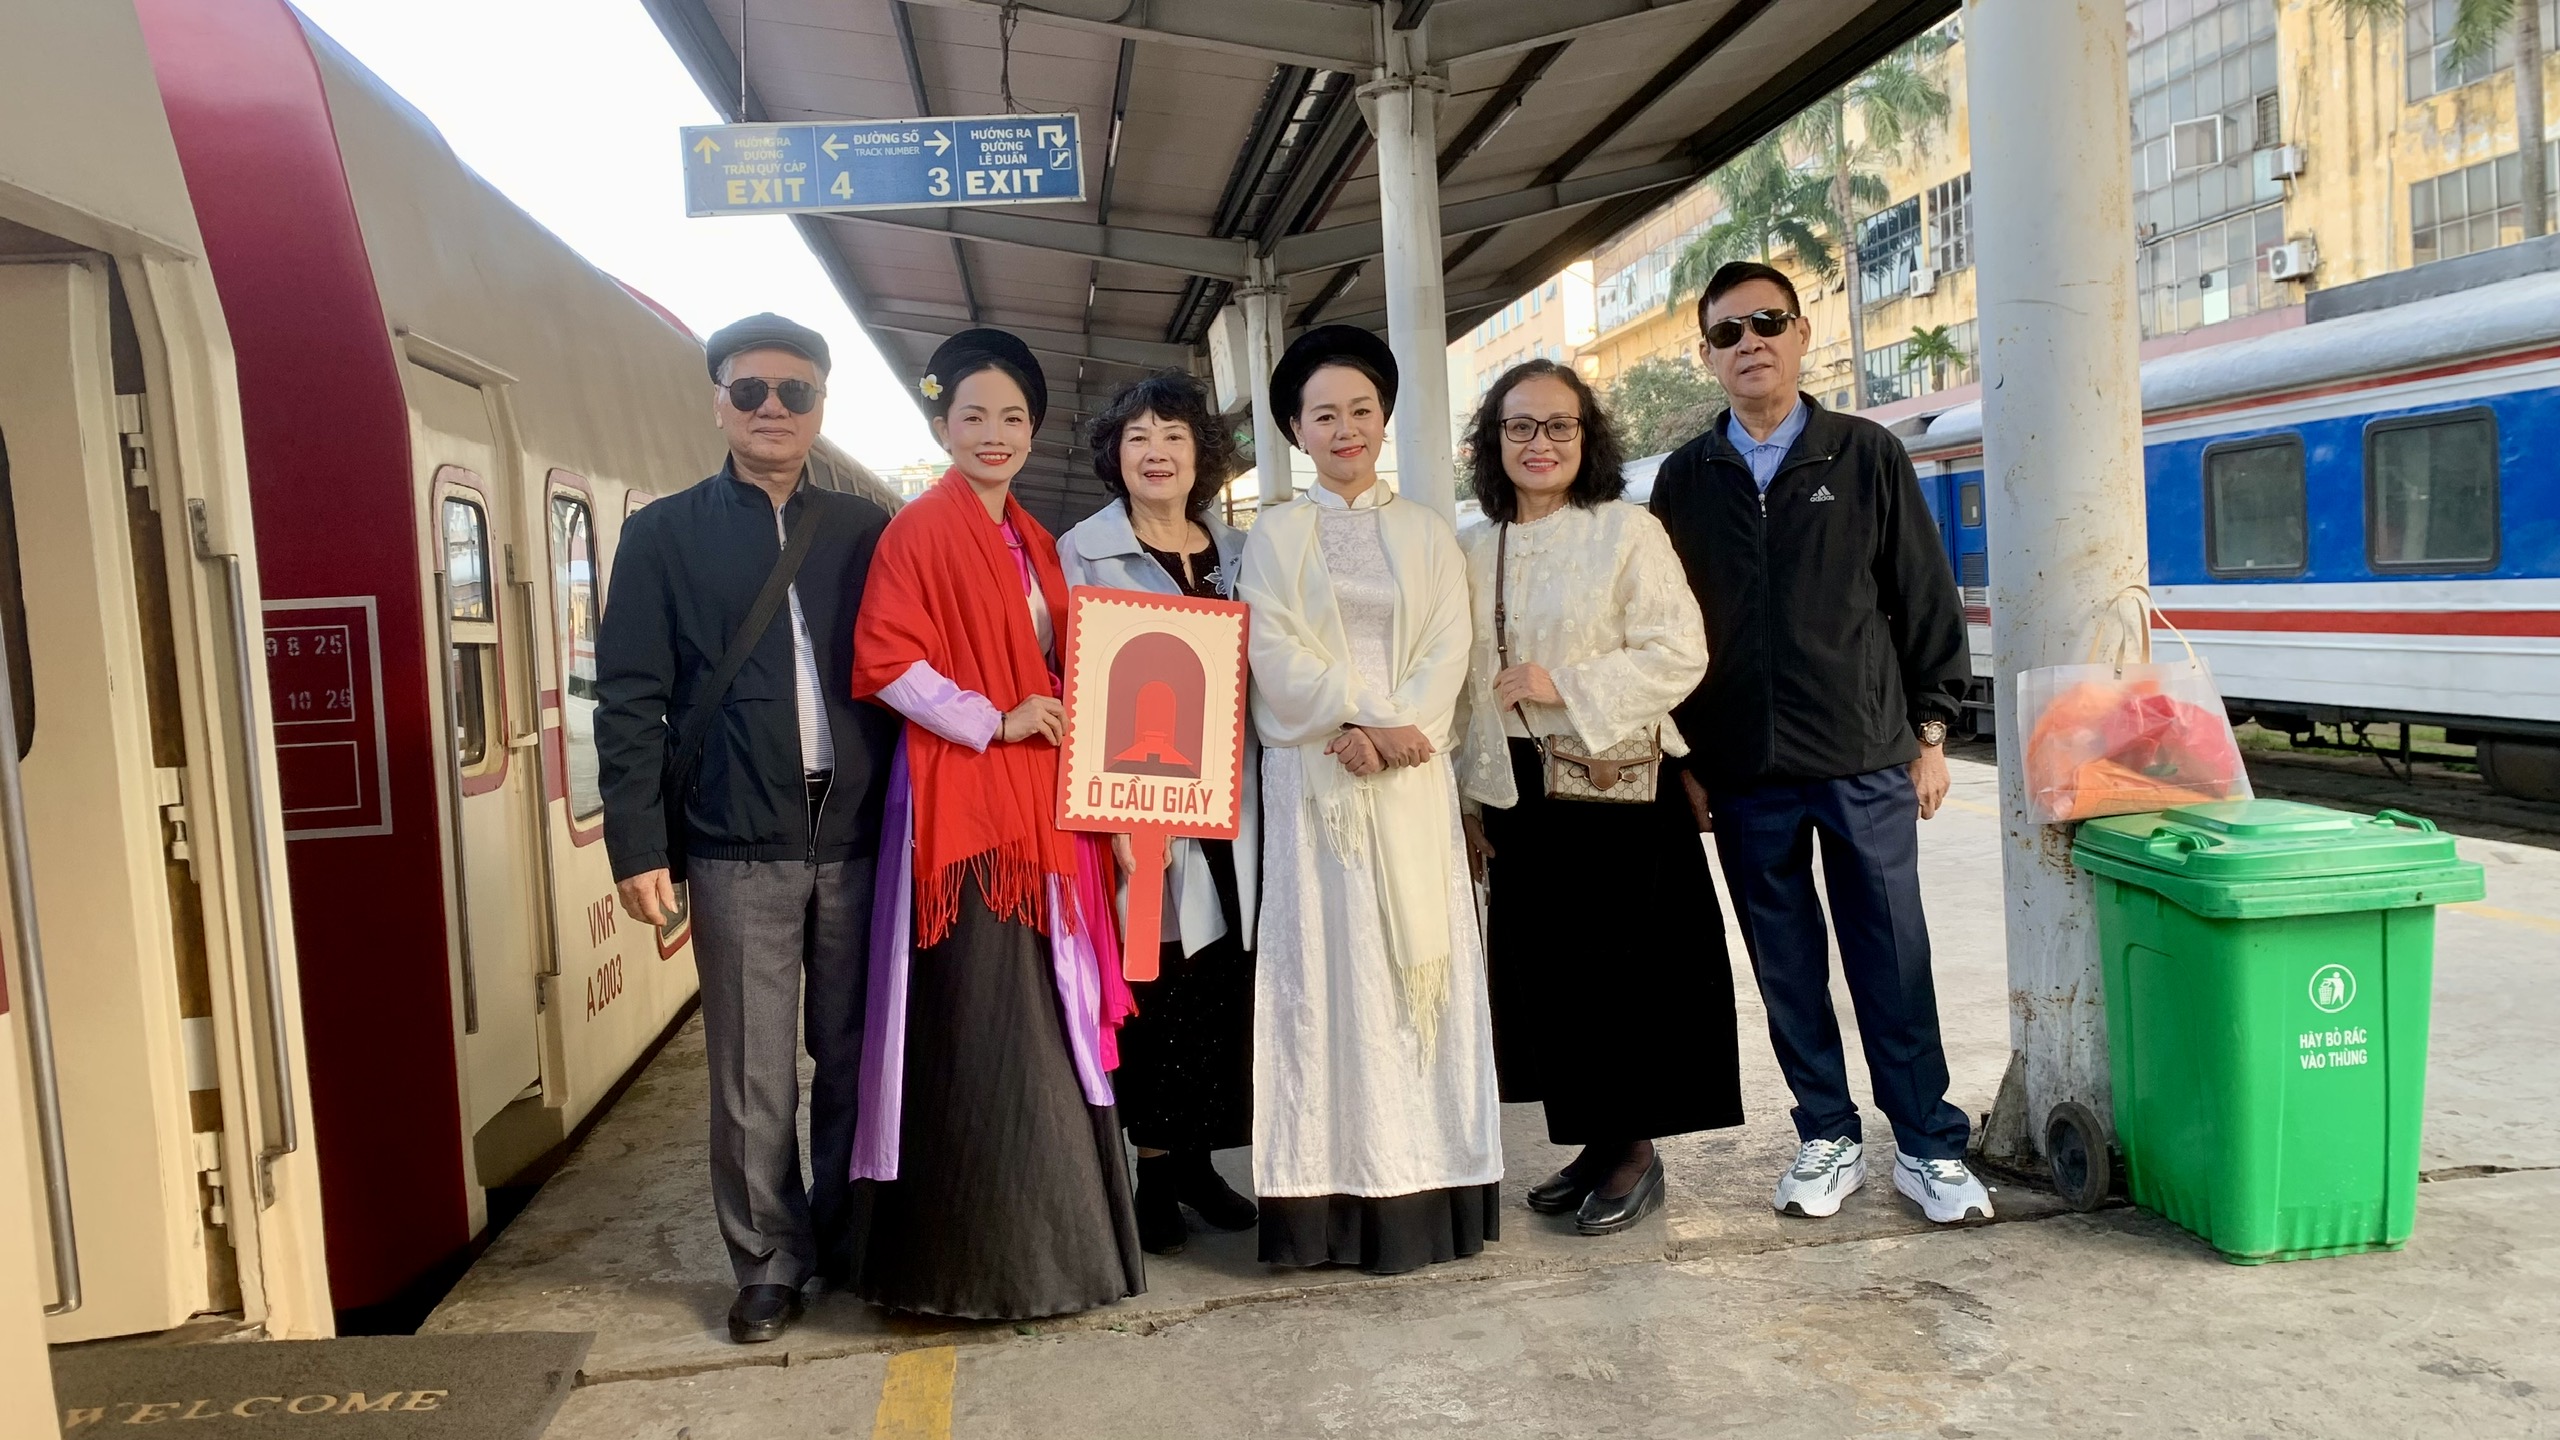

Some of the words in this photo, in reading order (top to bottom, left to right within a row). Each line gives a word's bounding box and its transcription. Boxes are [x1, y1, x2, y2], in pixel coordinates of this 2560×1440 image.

[776, 137, 792, 147] RA
[852, 130, 900, 145] ĐƯỜNG
[970, 126, 1014, 140] HƯỚNG
[1016, 128, 1032, 138] RA
[854, 147, 882, 157] TRACK
[884, 146, 921, 156] NUMBER
[980, 139, 1024, 152] ĐƯỜNG
[756, 160, 782, 176] QUÝ
[979, 152, 992, 165] LÊ
[726, 177, 806, 205] EXIT
[829, 171, 855, 200] 4
[927, 167, 951, 197] 3
[965, 168, 1044, 195] EXIT
[286, 636, 300, 656] 8
[314, 634, 342, 655] 25
[288, 690, 312, 711] 10
[1087, 775, 1103, 807] Ô
[1110, 775, 1155, 811] CẦU
[1163, 780, 1214, 815] GIẤY
[587, 893, 616, 949] VNR
[586, 976, 597, 1023] A
[597, 953, 624, 1012] 2003
[2343, 1026, 2368, 1046] RÁC
[2300, 1050, 2326, 1070] VÀO
[2328, 1047, 2368, 1068] THÙNG
[65, 1390, 449, 1430] WELCOME
